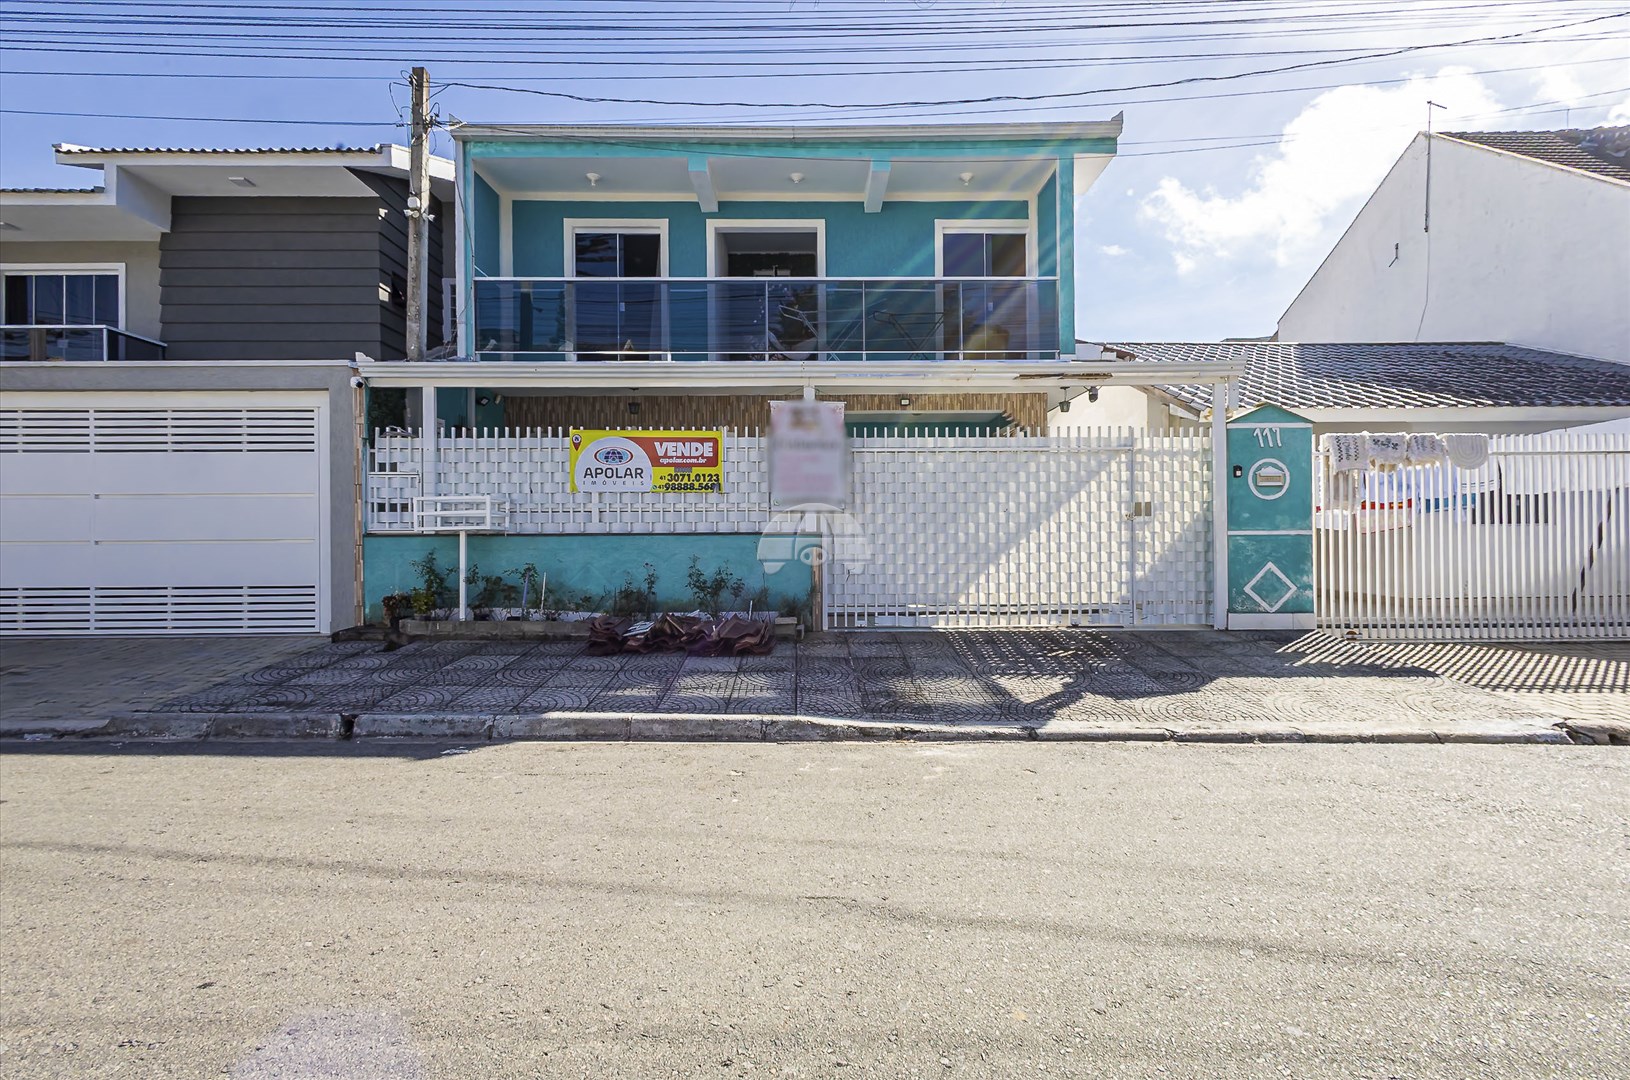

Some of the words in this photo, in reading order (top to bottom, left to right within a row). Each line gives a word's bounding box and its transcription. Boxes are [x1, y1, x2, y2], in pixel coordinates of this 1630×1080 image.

[654, 441, 714, 457] VENDE
[659, 457, 707, 465] apolar.com.br
[583, 467, 644, 479] APOLAR
[667, 473, 720, 482] 3071.0123
